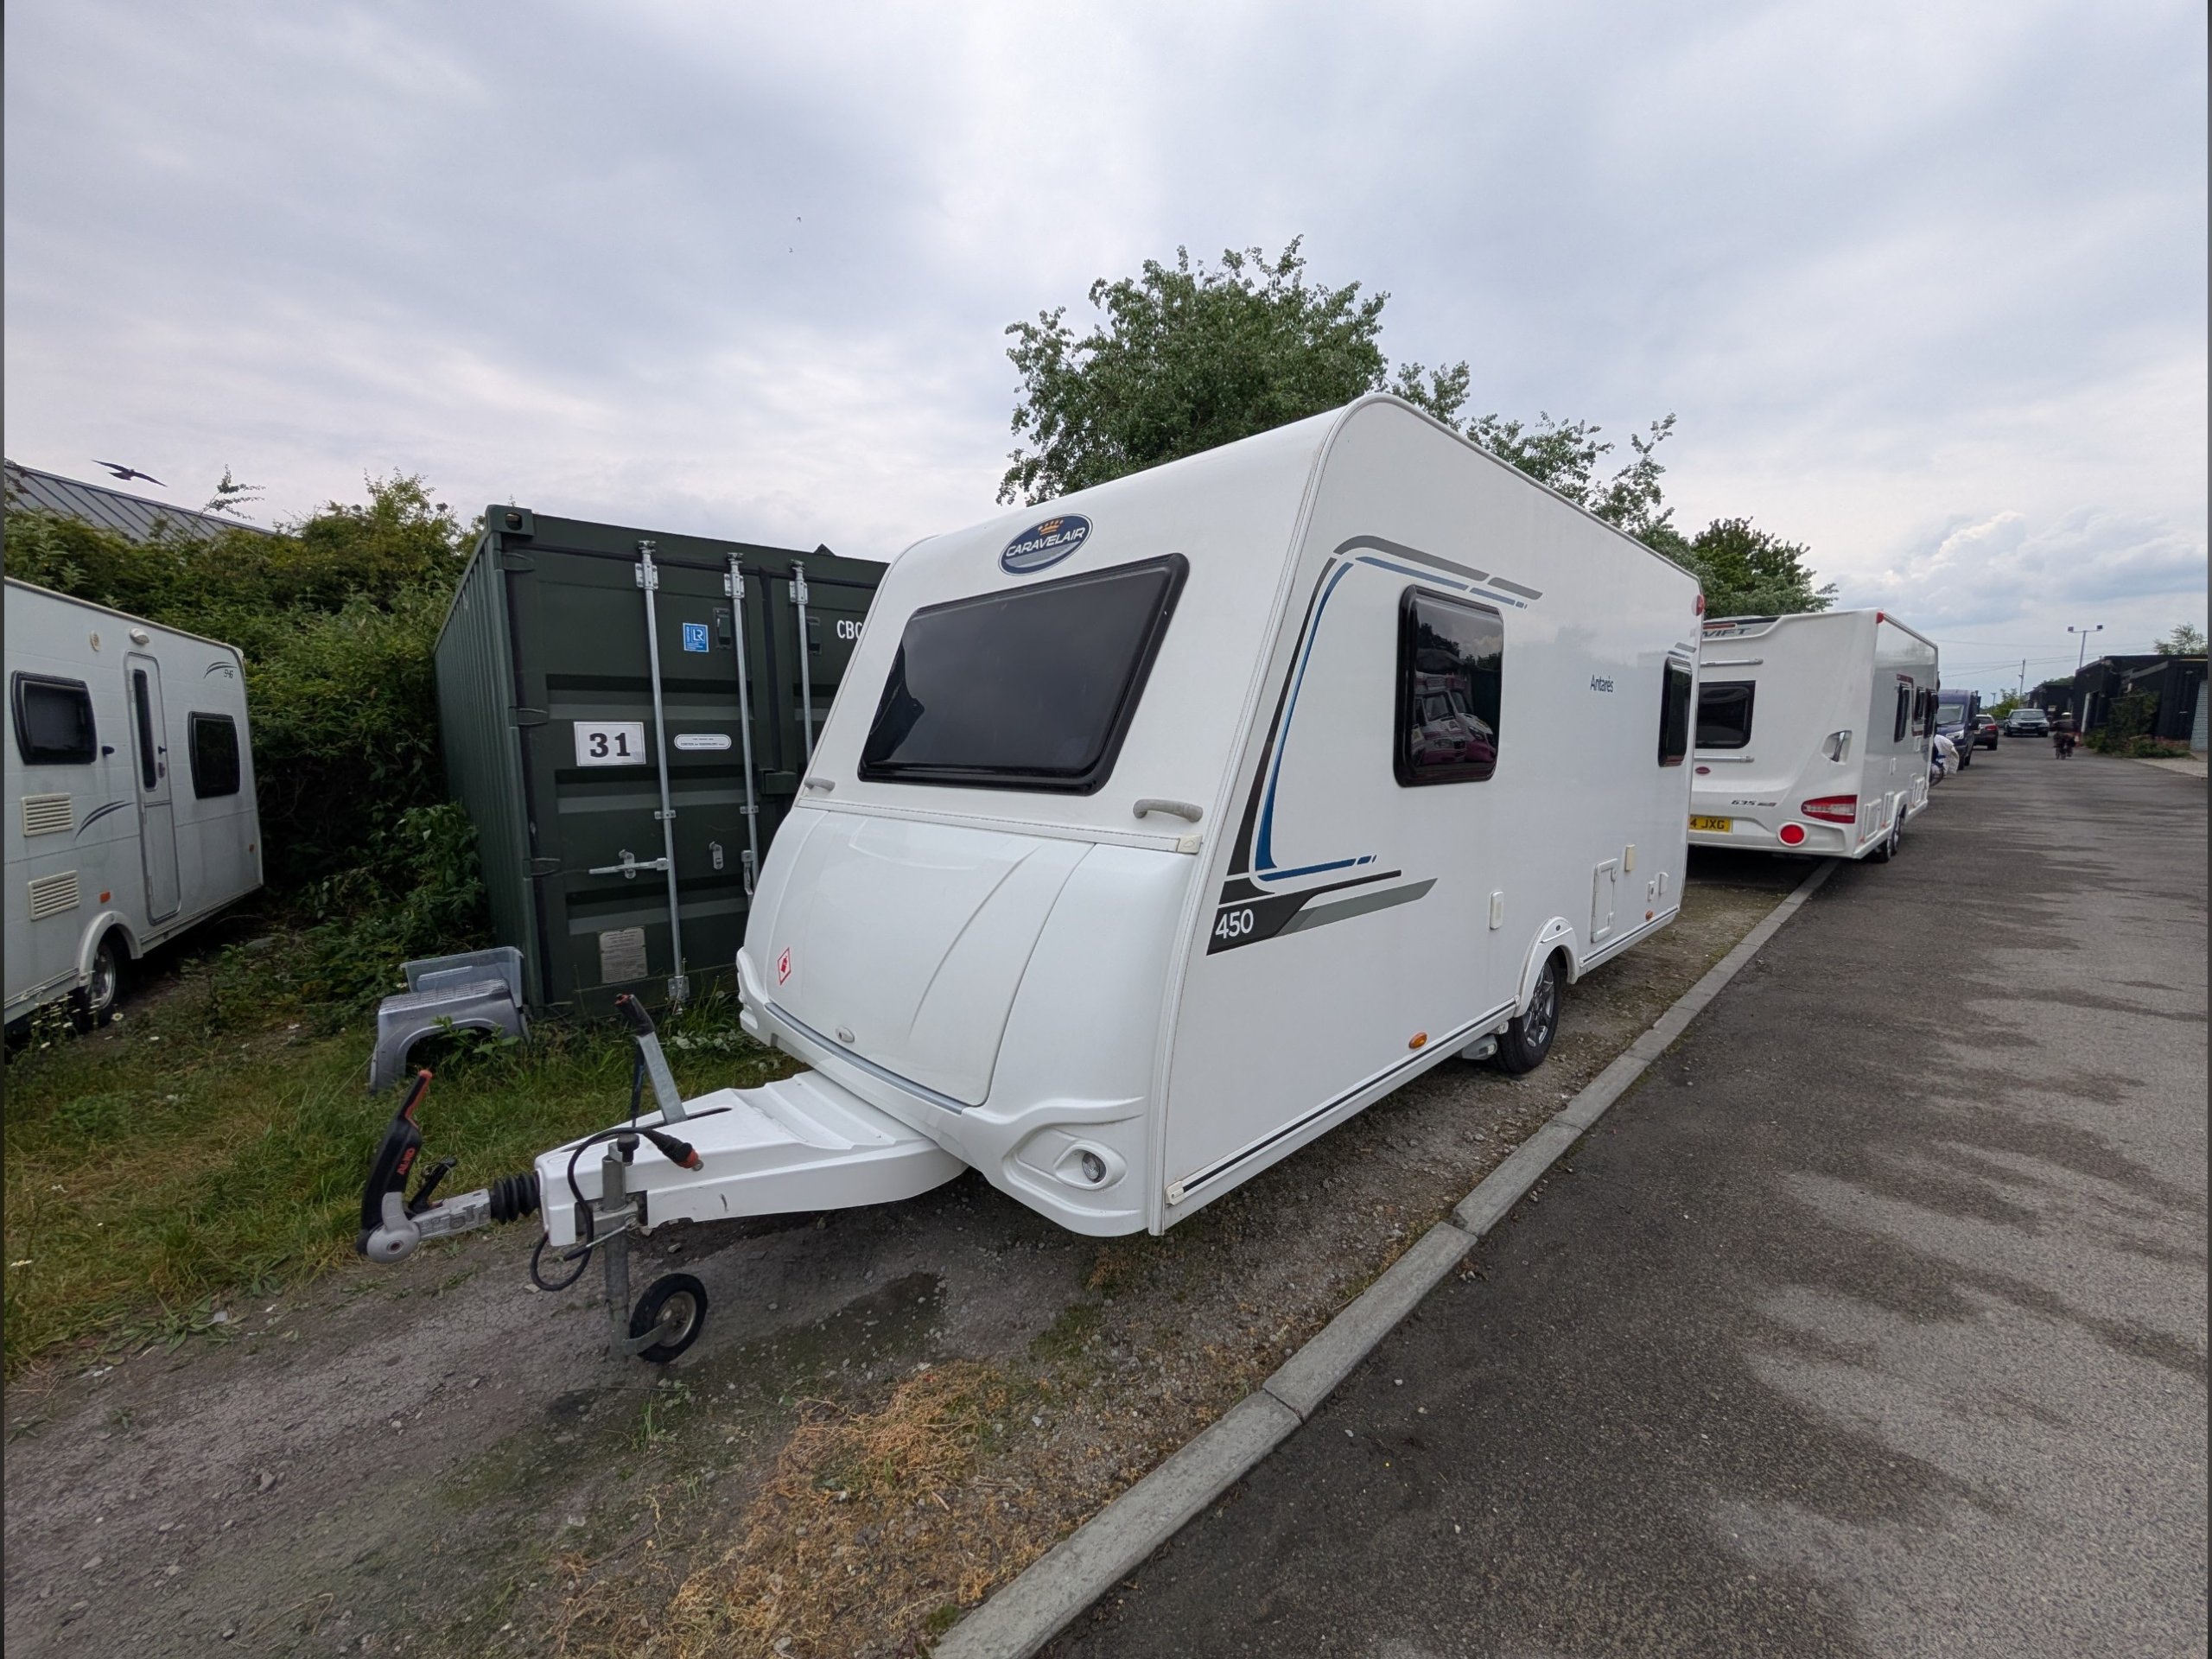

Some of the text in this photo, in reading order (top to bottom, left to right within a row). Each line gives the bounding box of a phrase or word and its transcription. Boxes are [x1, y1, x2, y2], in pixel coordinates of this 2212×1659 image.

[1006, 526, 1086, 557] CARAVELAIR
[693, 628, 704, 641] LR
[1590, 674, 1614, 693] Antarès
[589, 732, 631, 758] 31
[1700, 818, 1725, 830] JXG
[1215, 908, 1255, 939] 450
